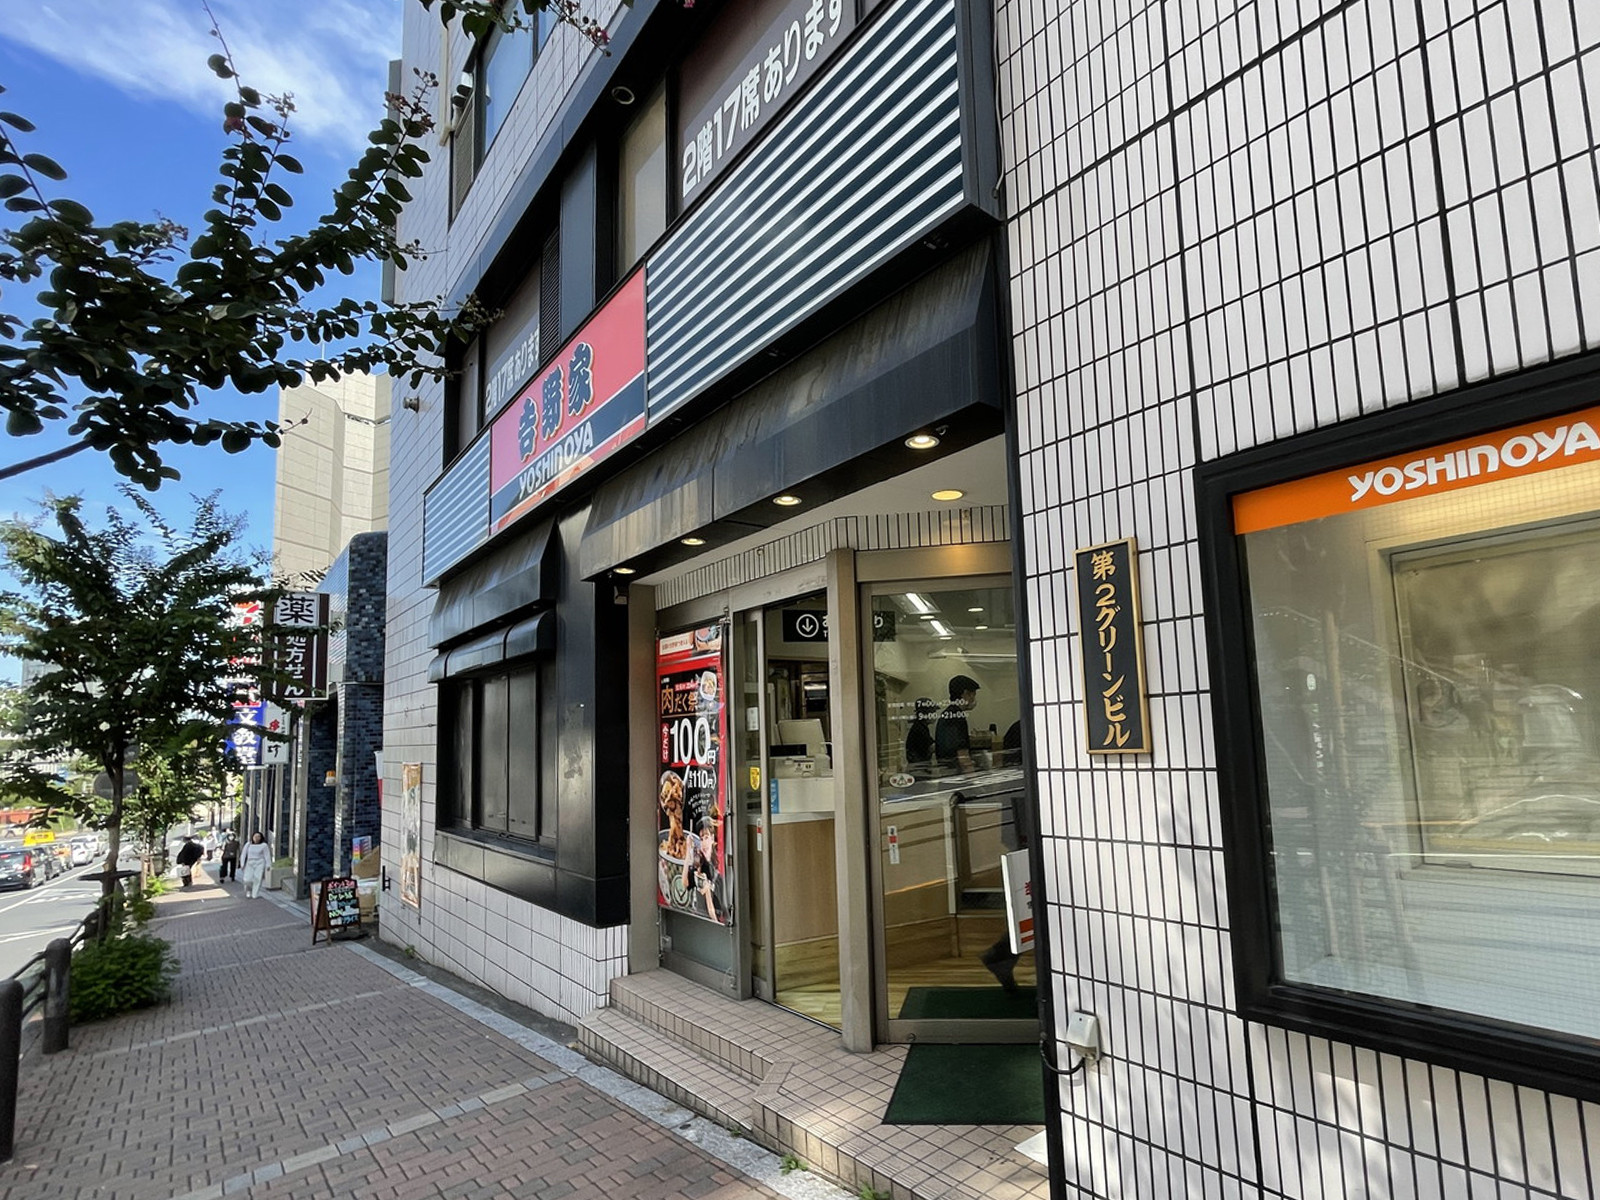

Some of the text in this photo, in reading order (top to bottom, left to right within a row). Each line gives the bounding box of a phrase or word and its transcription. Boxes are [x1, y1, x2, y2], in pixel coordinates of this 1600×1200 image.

[519, 421, 594, 500] YOSHINOYA
[1348, 421, 1600, 502] YOSHINOYA
[280, 597, 315, 624] 薬
[1091, 549, 1131, 748] 第2グリーンビル
[670, 717, 716, 765] 100円
